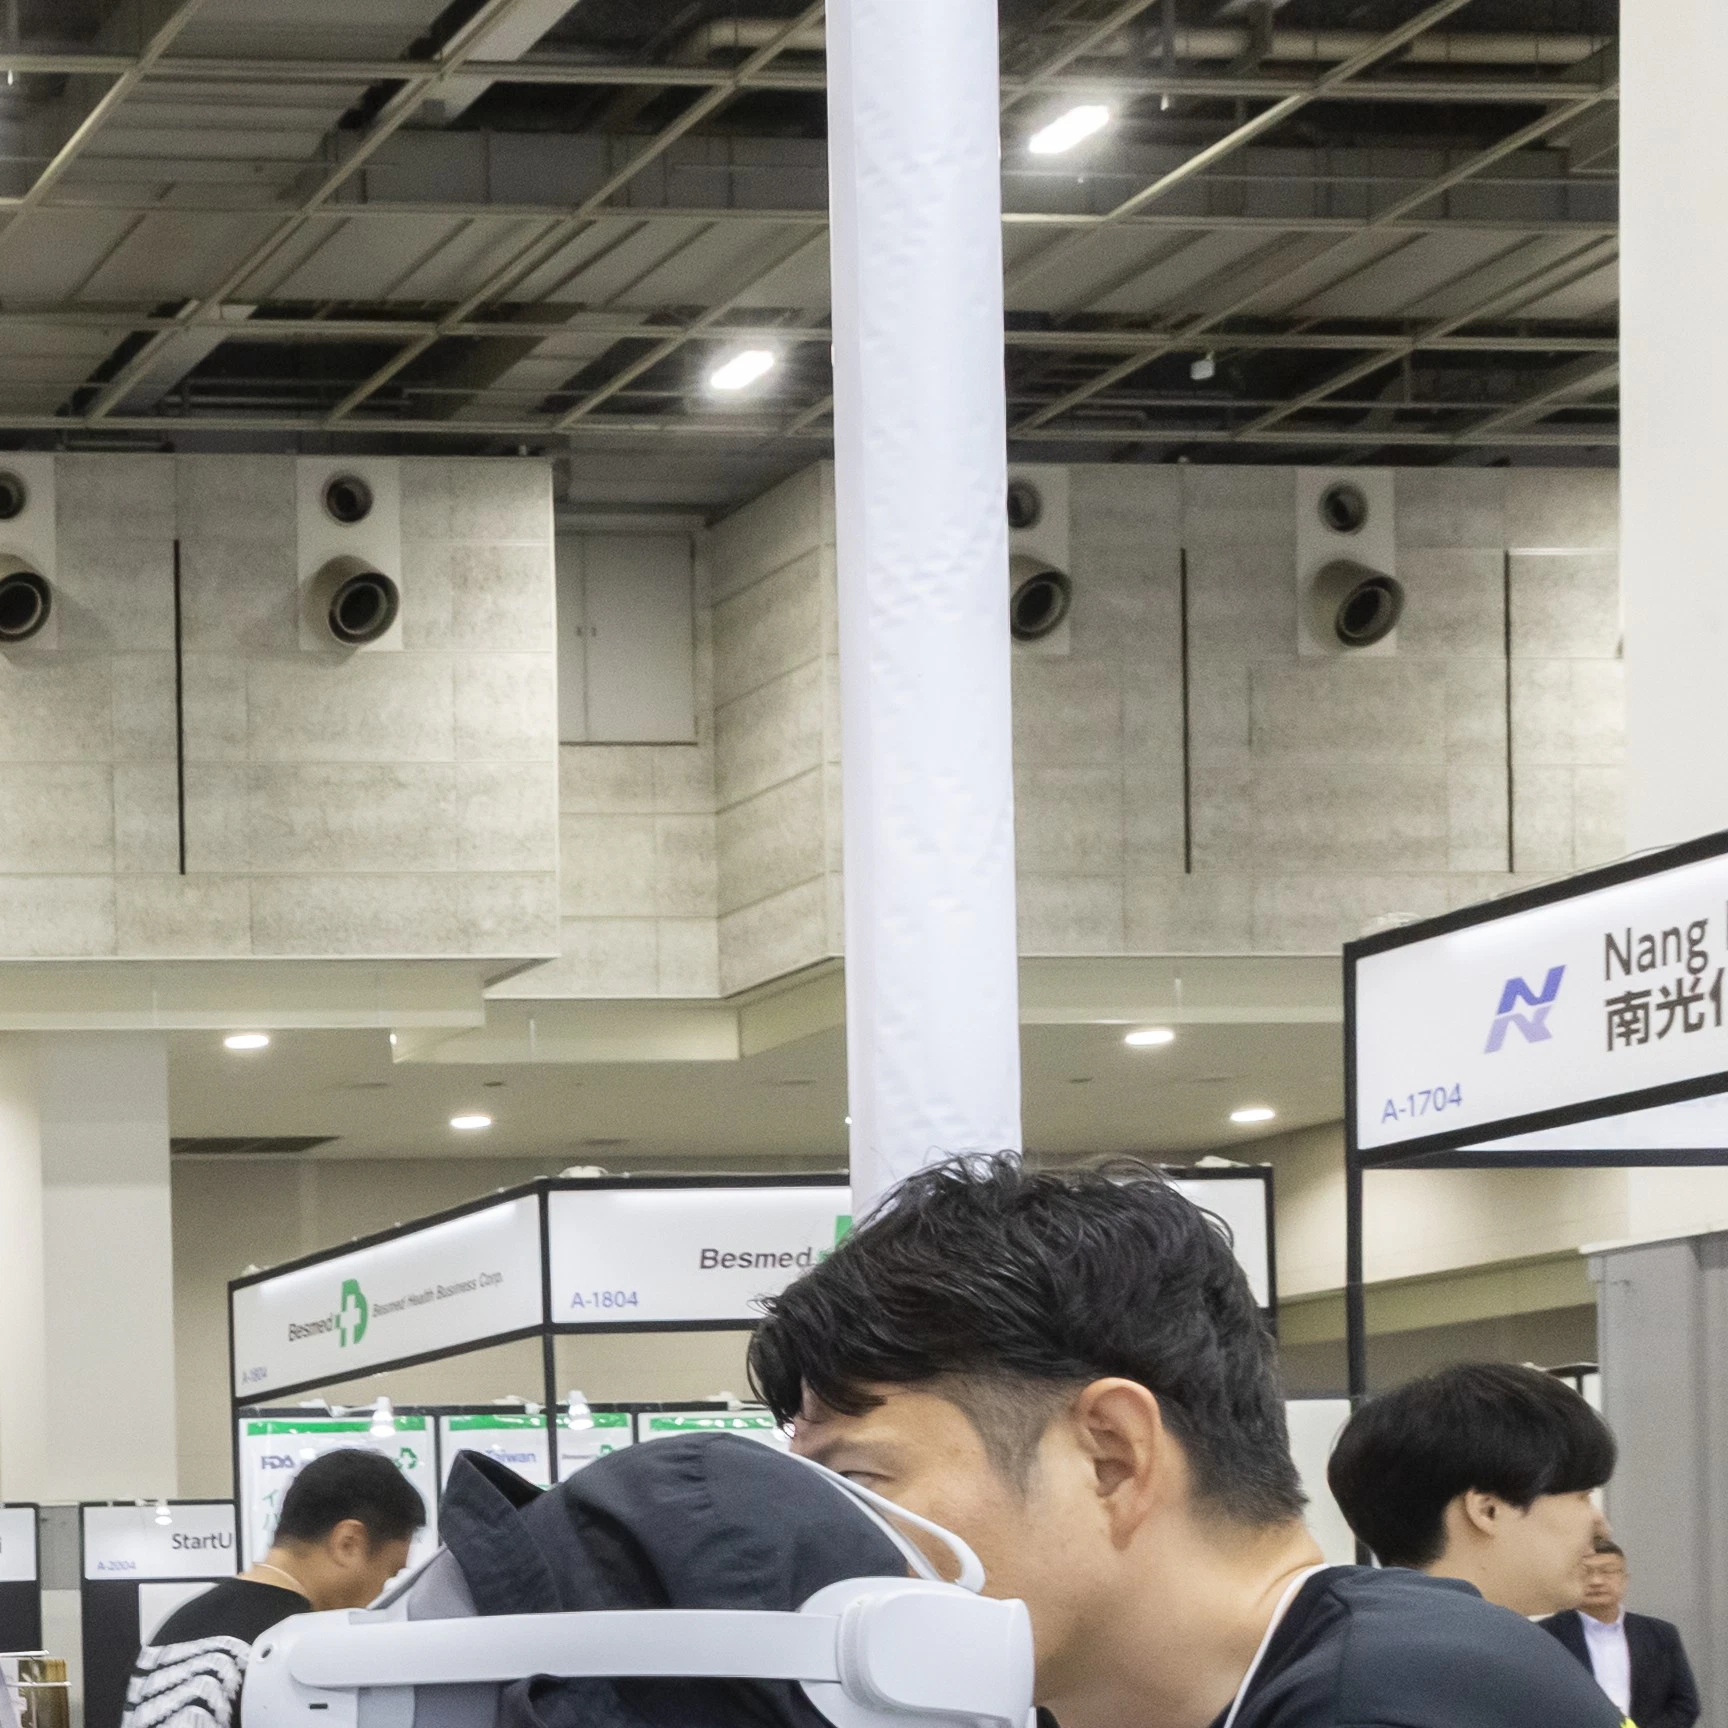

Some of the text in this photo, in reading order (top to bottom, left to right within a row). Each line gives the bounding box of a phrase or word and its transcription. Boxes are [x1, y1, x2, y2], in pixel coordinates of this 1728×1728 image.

[1604, 917, 1709, 981] Nang
[1381, 1083, 1464, 1124] A-1704
[699, 1246, 814, 1269] Besmed
[570, 1291, 640, 1309] A-1804
[287, 1313, 335, 1342] Besmed
